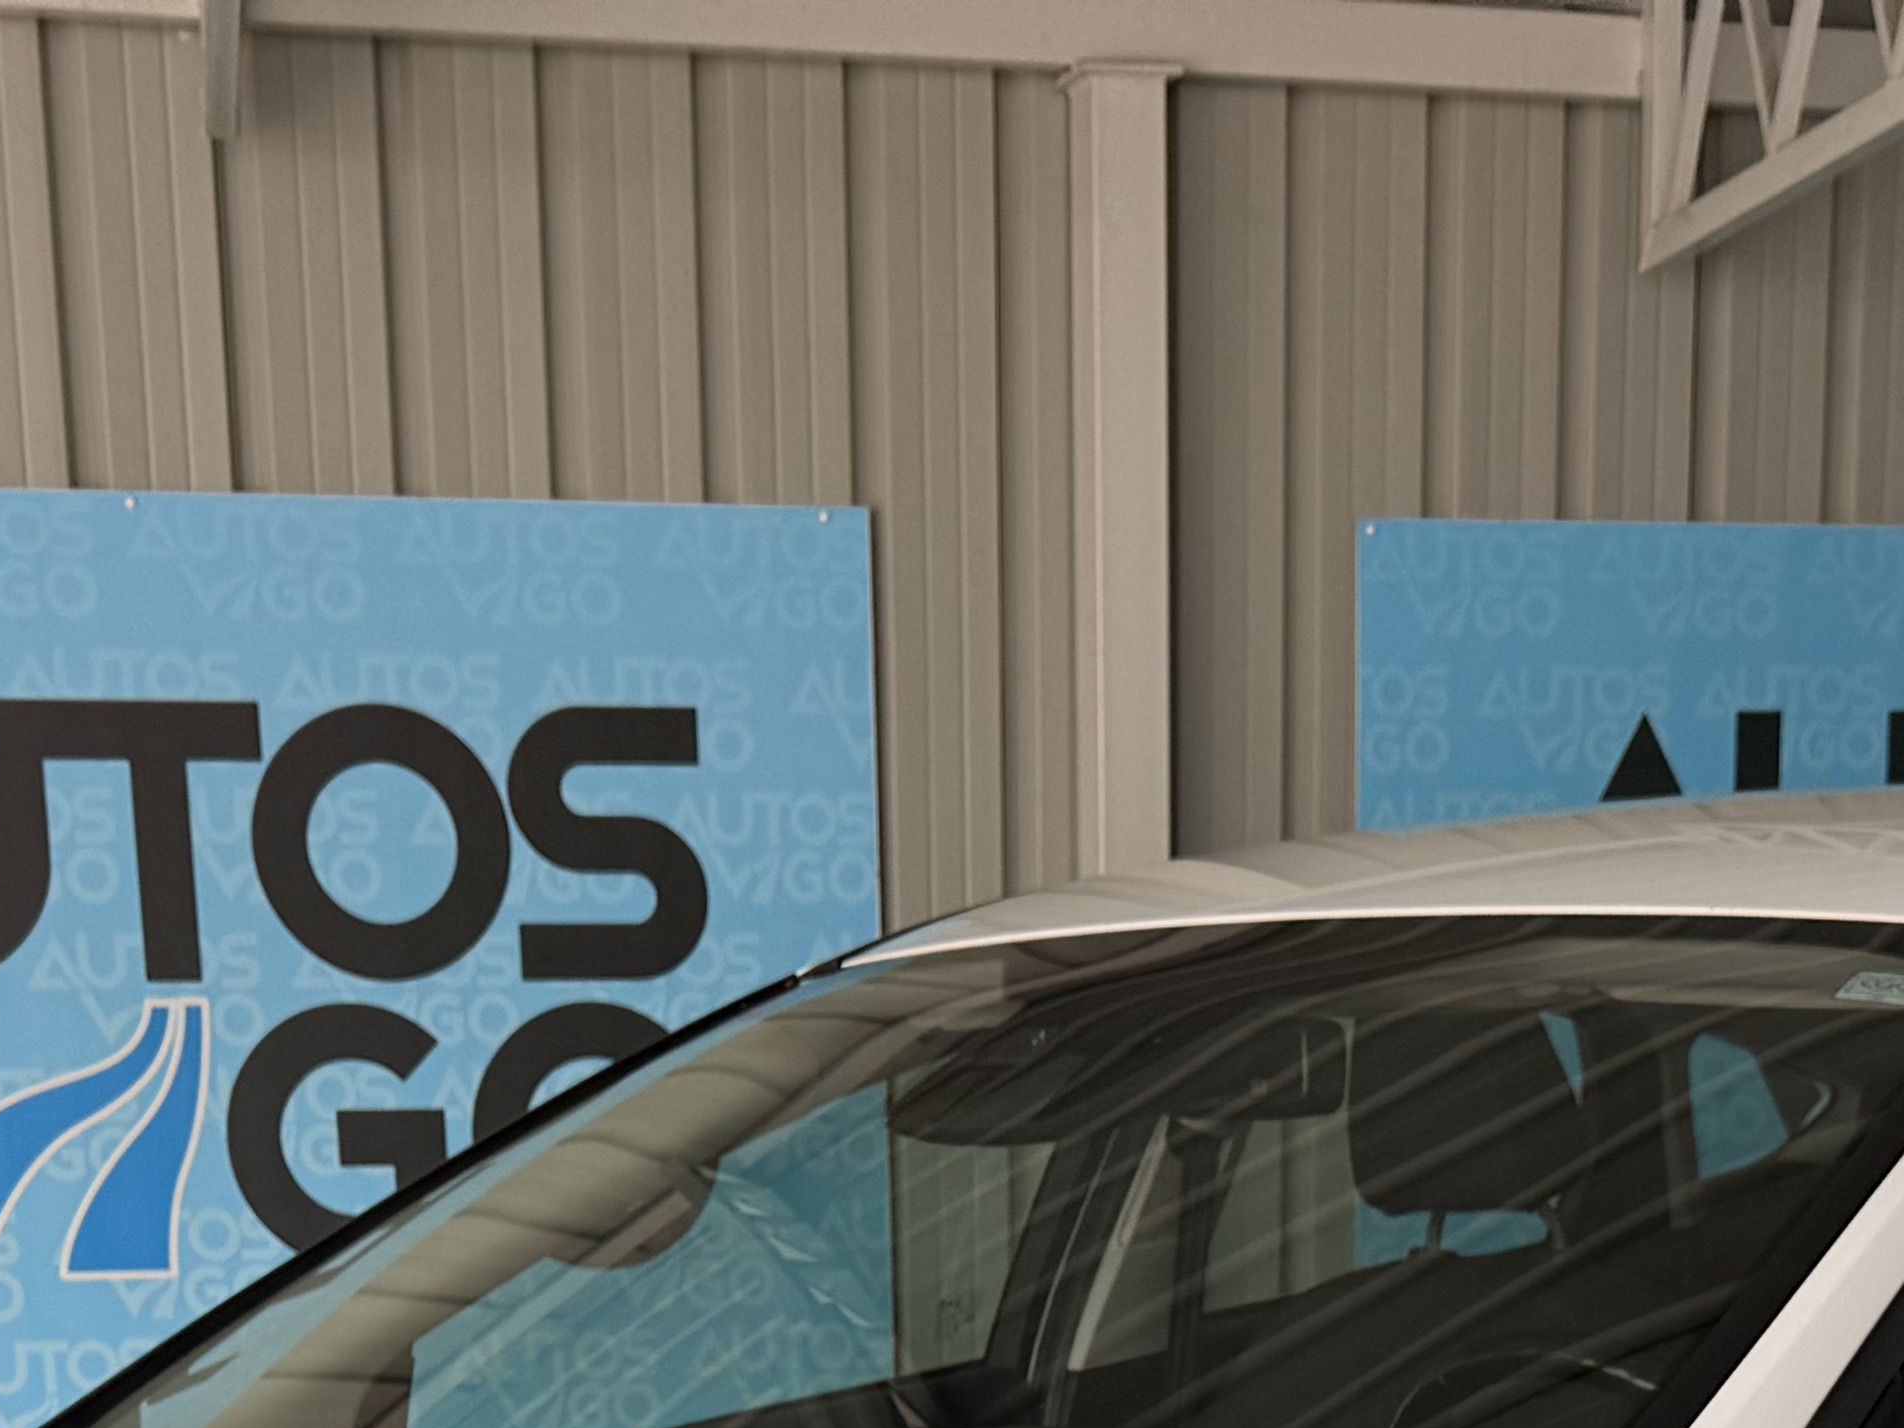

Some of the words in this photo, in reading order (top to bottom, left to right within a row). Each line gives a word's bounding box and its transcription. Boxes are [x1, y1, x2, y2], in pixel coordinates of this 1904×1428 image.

[127, 500, 362, 562] AUTOS
[396, 505, 620, 567] AUTOS
[651, 514, 868, 573] AUTOS
[1364, 528, 1562, 582] AUTOS
[1589, 531, 1780, 583] AUTOS
[178, 561, 366, 623] VIGO
[445, 568, 623, 626] VIGO
[1408, 587, 1562, 638] VIGO
[1630, 586, 1780, 639] VIGO
[7, 648, 242, 697] AUTOS
[1475, 664, 1670, 718] AUTOS
[1699, 664, 1884, 715] AUTOS
